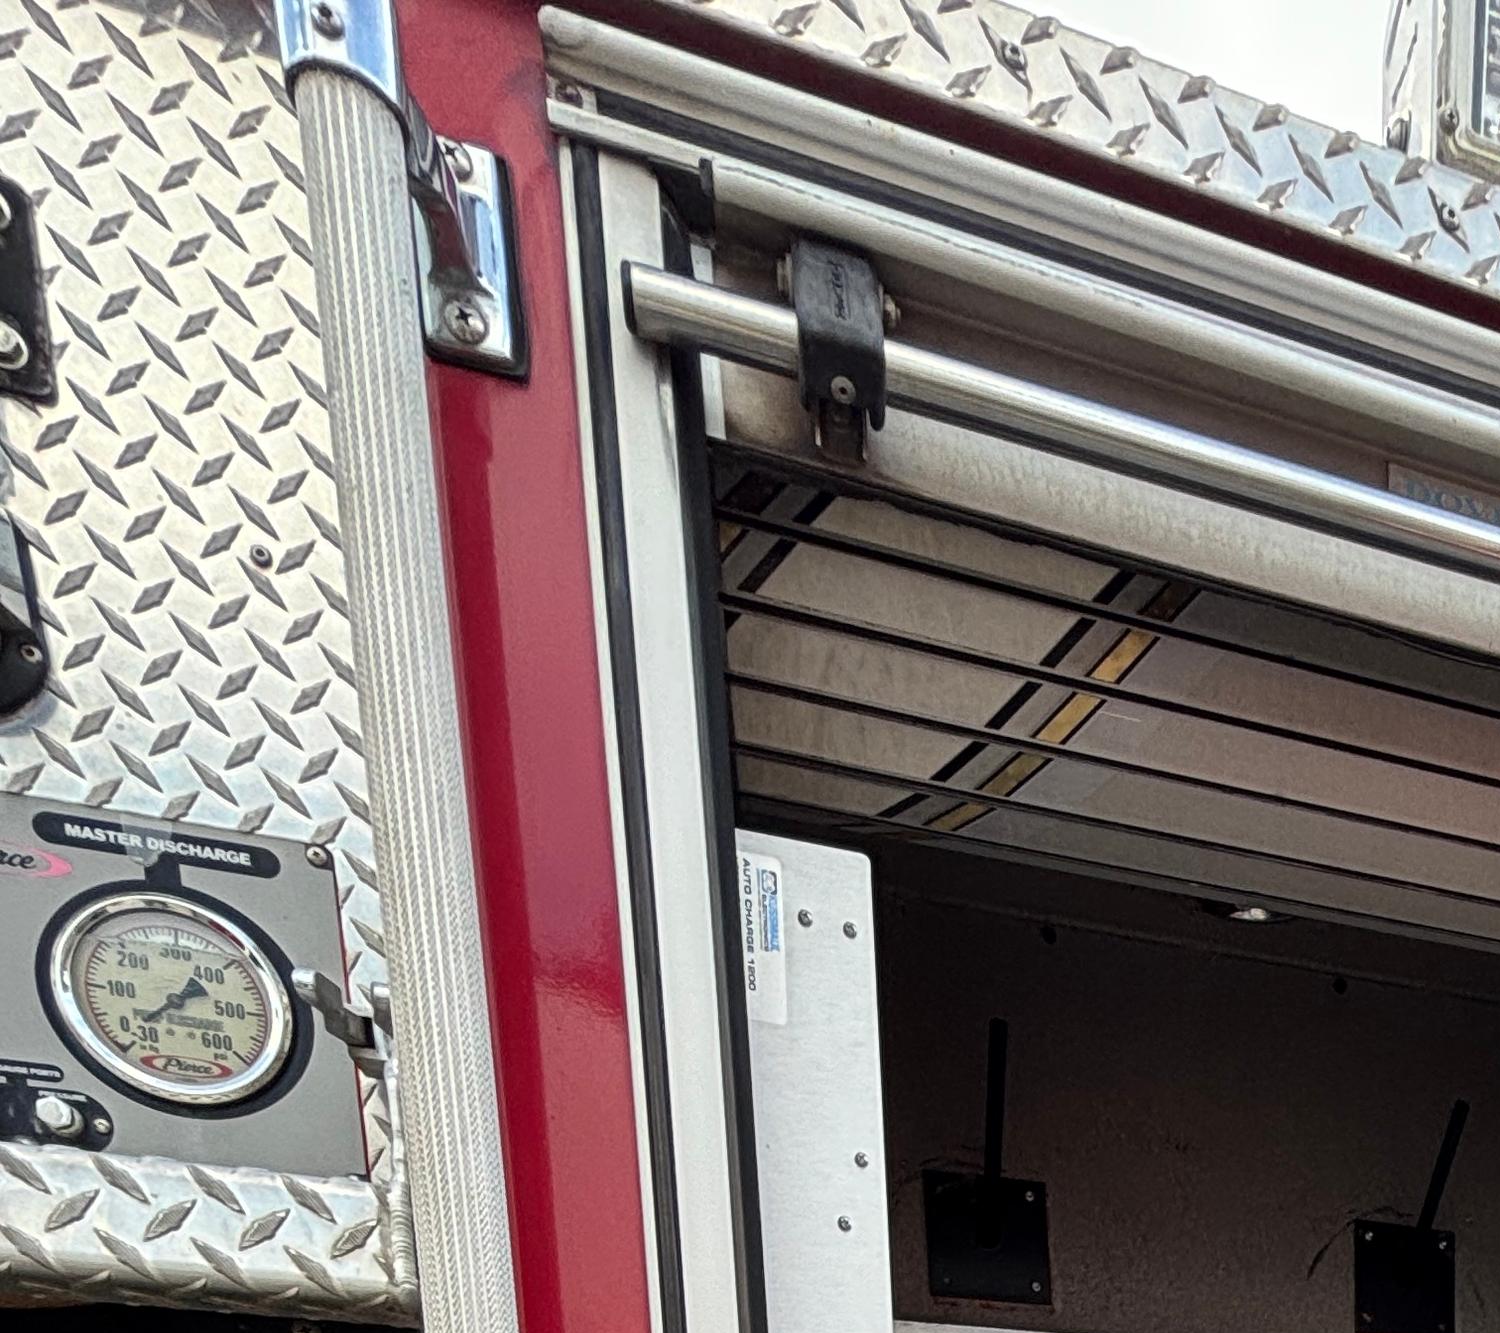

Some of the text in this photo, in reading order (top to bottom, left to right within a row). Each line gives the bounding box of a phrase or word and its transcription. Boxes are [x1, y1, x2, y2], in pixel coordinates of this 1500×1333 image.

[63, 823, 252, 867] MASTER DISCHARGE
[742, 857, 757, 992] AUTO CHARGE 1200
[117, 950, 150, 971] 200
[193, 965, 225, 985] 400
[107, 979, 137, 999] 100
[214, 1000, 246, 1020] 500
[119, 1015, 131, 1033] 0
[200, 1031, 233, 1052] 600
[162, 1055, 216, 1077] Pierce
